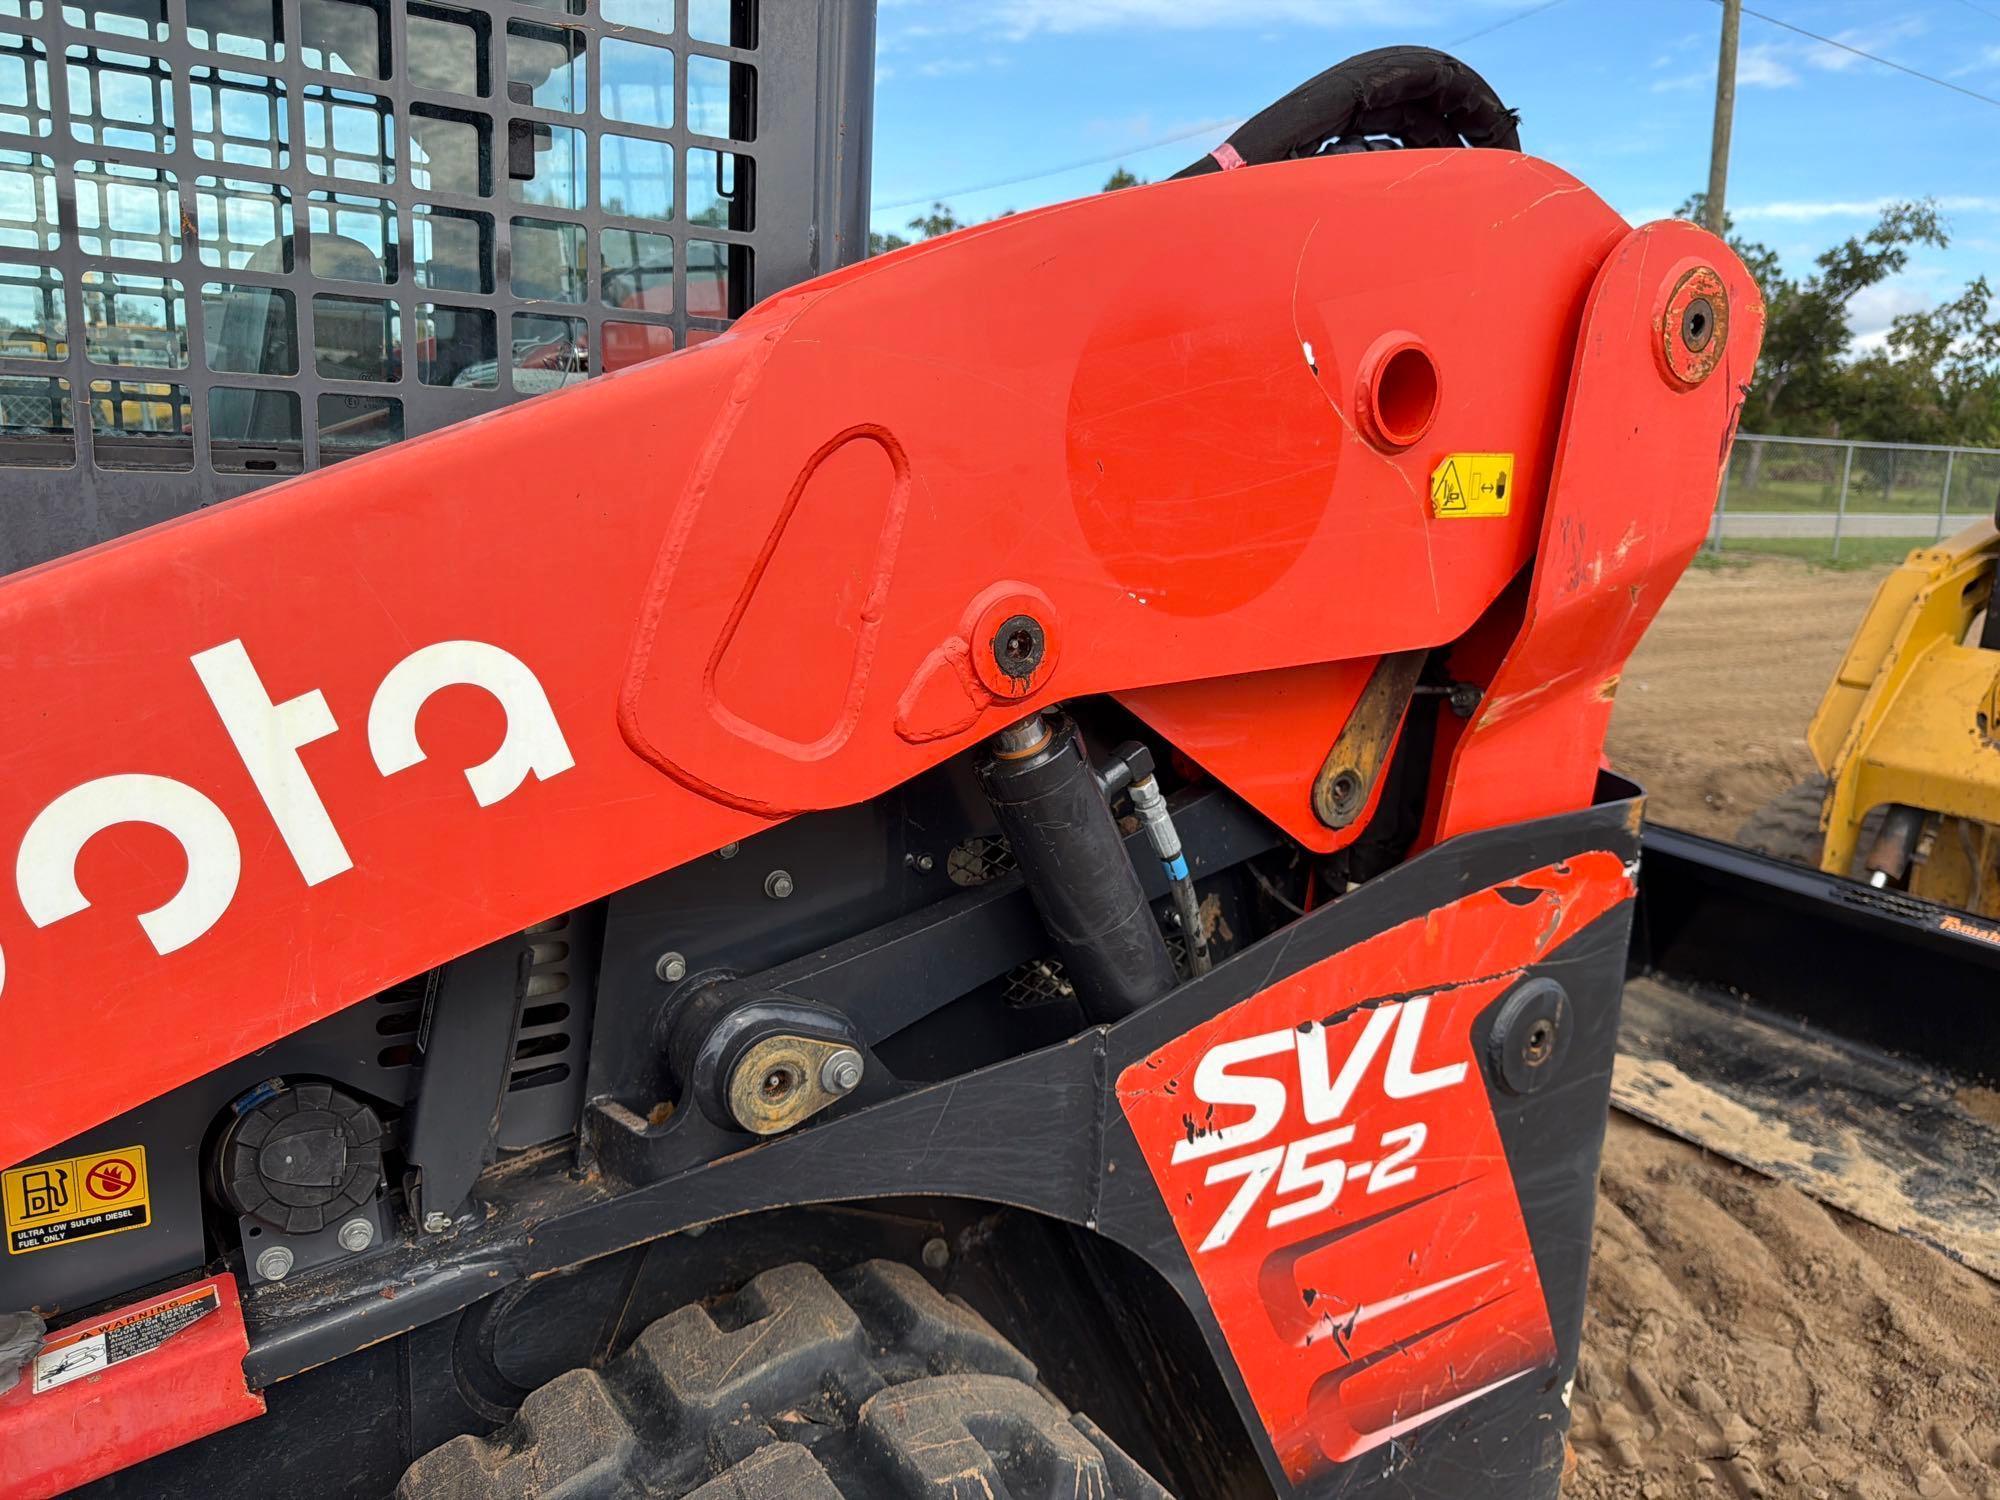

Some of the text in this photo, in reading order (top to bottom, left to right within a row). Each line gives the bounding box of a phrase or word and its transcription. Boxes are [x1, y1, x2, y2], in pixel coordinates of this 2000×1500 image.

[0, 638, 576, 1000] ota
[1171, 997, 1469, 1165] SVL
[1197, 1122, 1428, 1254] 75-2
[17, 1228, 45, 1240] ULTRA
[48, 1223, 67, 1234] LOW
[70, 1216, 102, 1229] SULFUR
[105, 1209, 133, 1221] DIESEL
[18, 1232, 66, 1249] FUEL ONLY
[98, 1300, 179, 1333] WARNING
[108, 1324, 141, 1340] INJURY
[144, 1318, 157, 1326] OR
[110, 1331, 137, 1344] Always
[164, 1316, 176, 1324] the
[189, 1306, 203, 1315] arm
[123, 1317, 151, 1330] AVOID
[155, 1299, 203, 1318] PERSONAL
[110, 1335, 139, 1349] stopper
[141, 1324, 166, 1337] before
[168, 1314, 197, 1327] working
[110, 1349, 123, 1357] the
[137, 1337, 156, 1347] arms
[120, 1336, 148, 1349] around
[150, 1330, 162, 1338] the
[111, 1340, 162, 1361] See Operato
